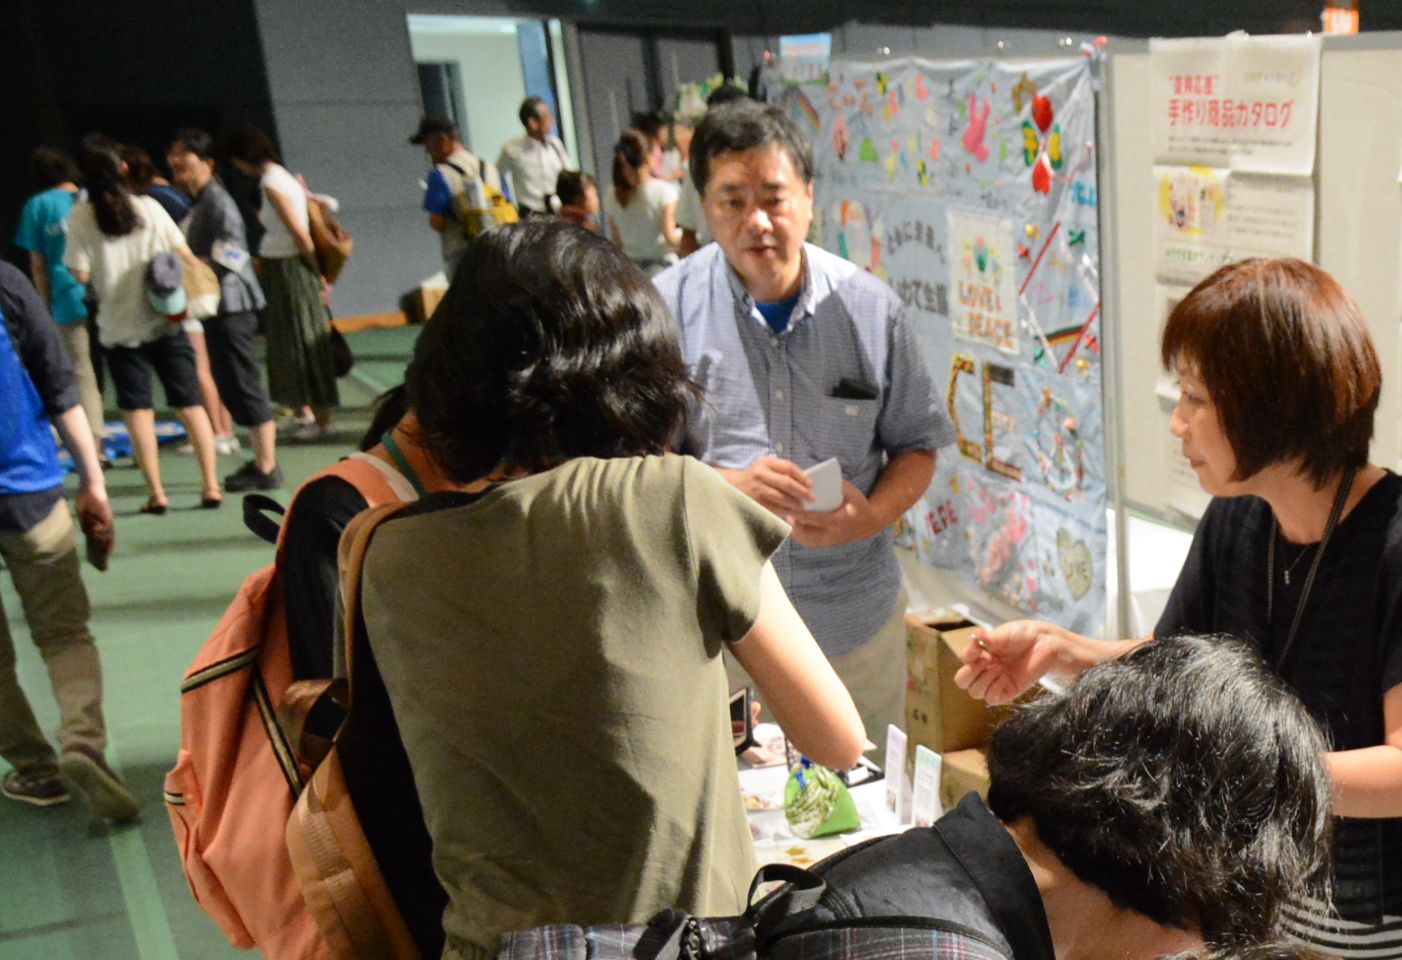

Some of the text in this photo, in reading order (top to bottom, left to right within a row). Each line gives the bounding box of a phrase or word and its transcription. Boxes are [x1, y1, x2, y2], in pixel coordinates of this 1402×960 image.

[1168, 98, 1295, 129] 手作り商品カタログ
